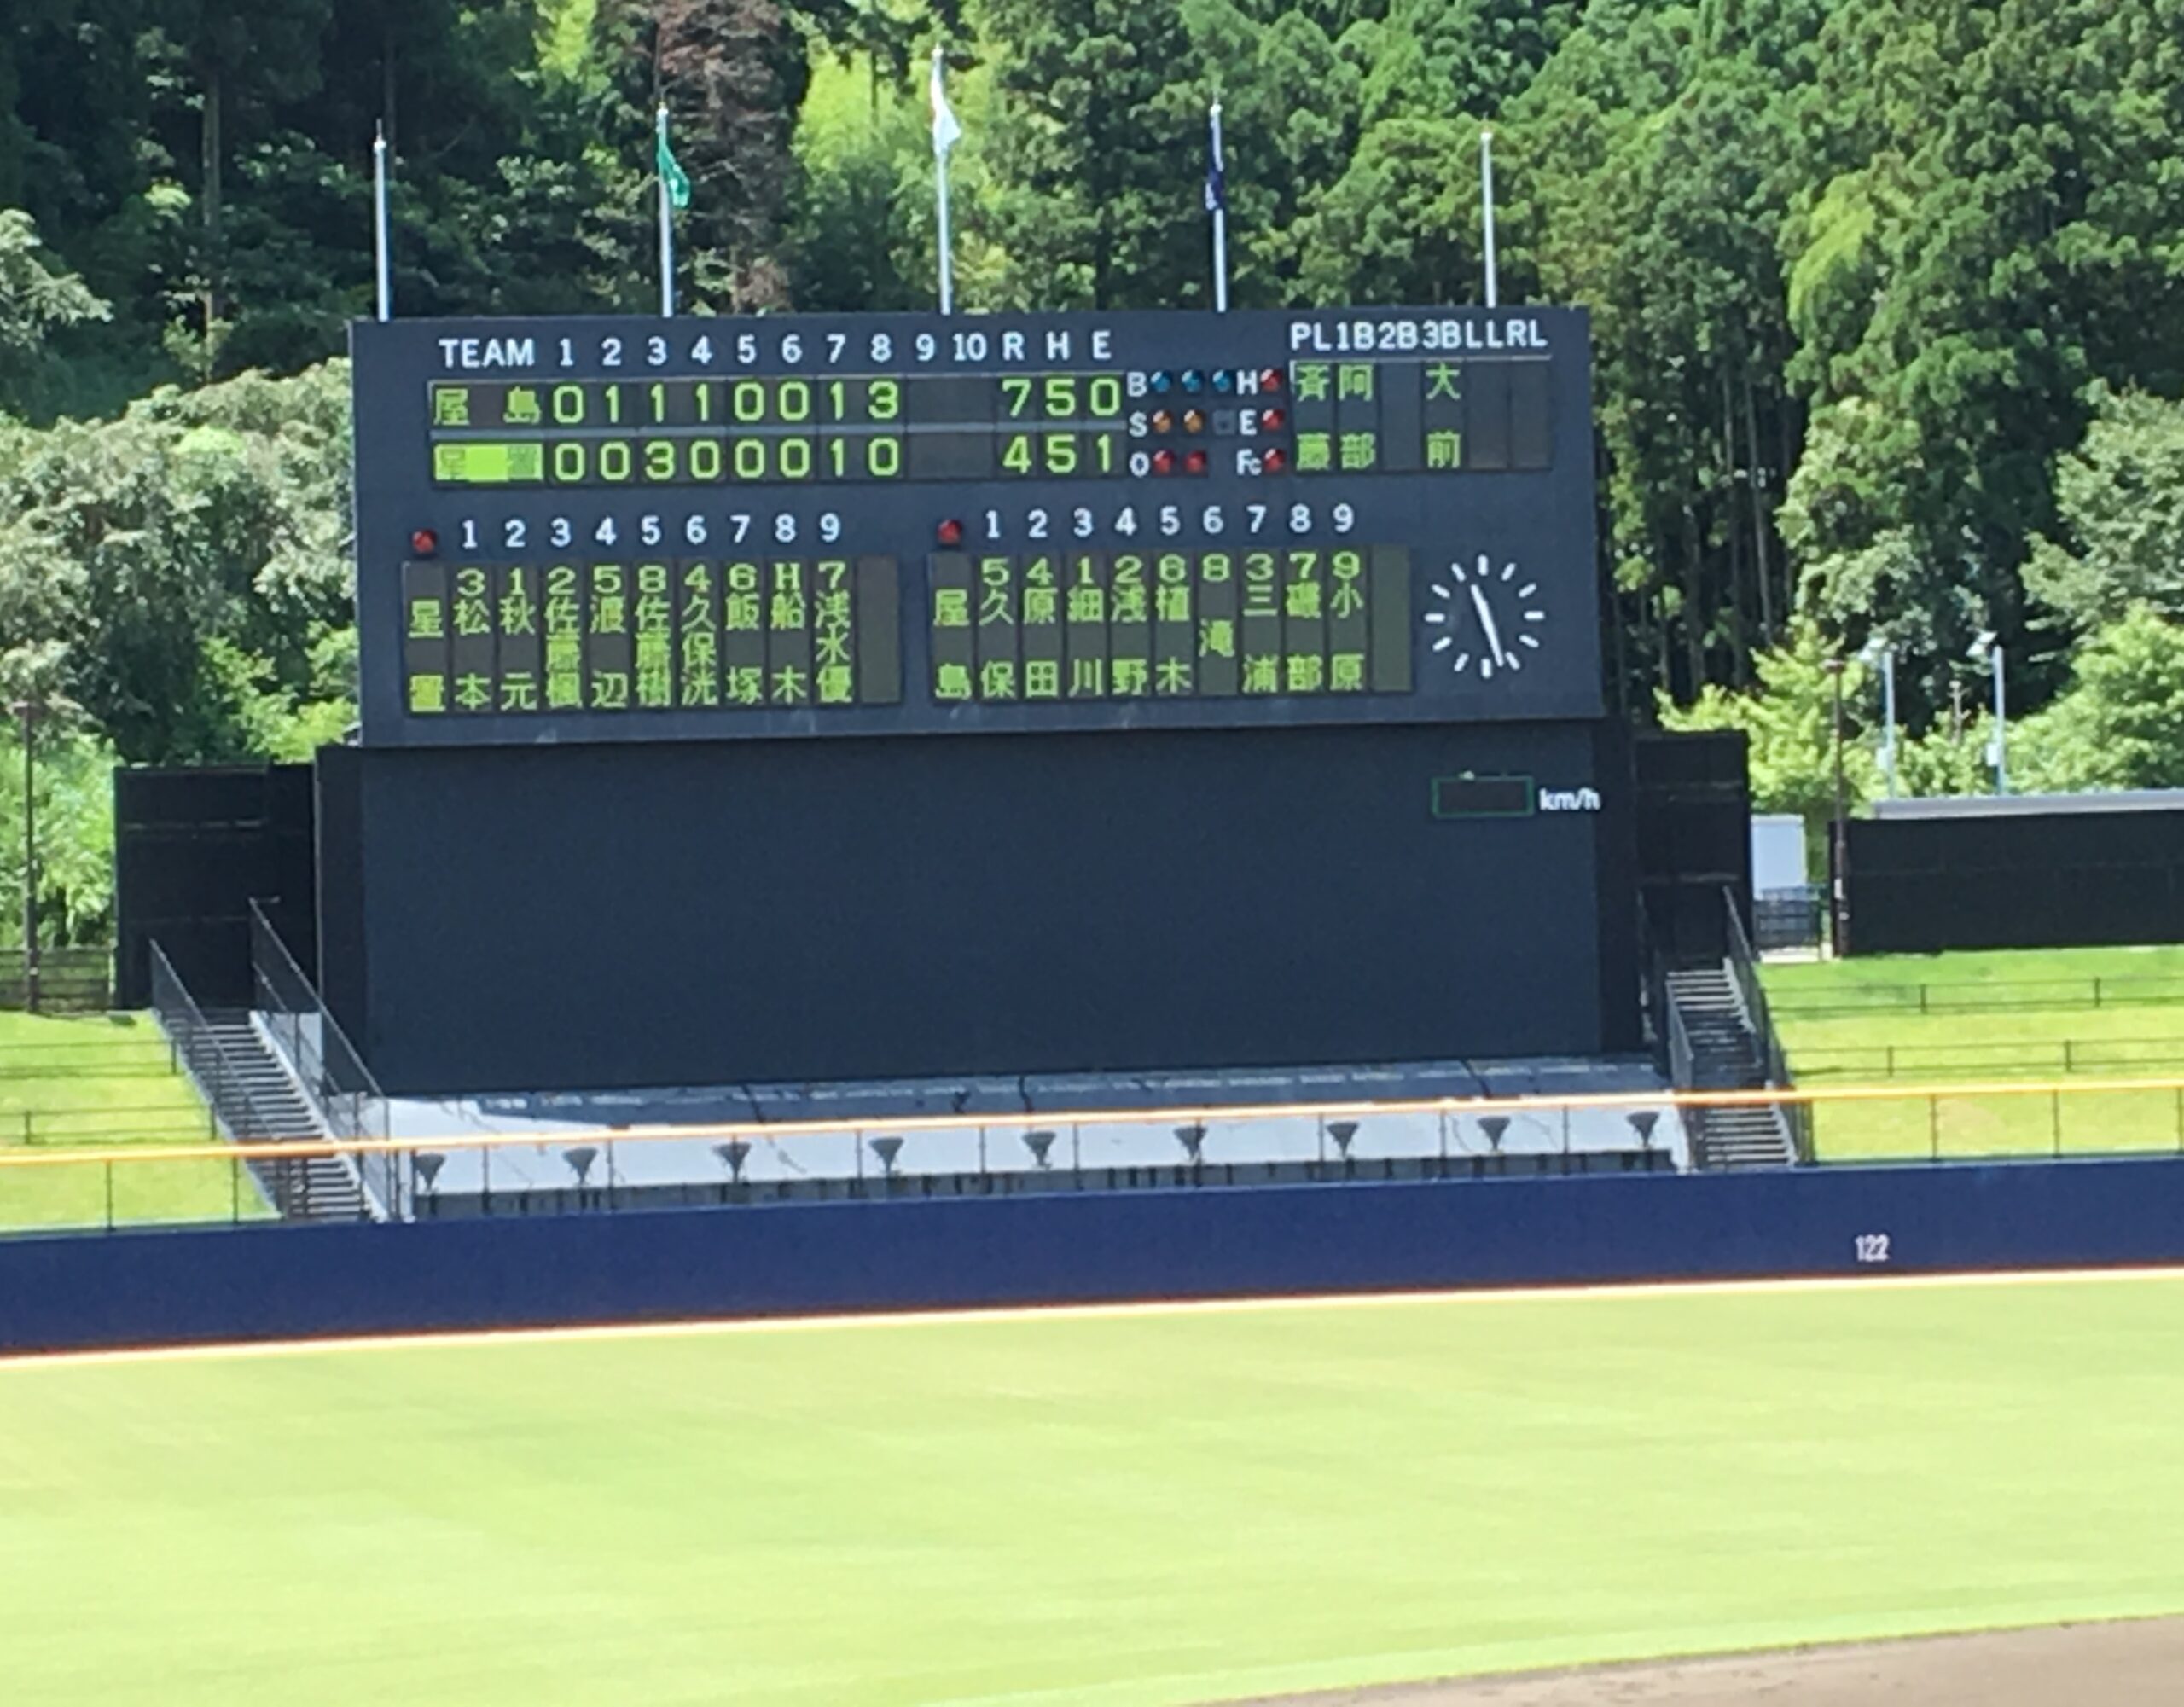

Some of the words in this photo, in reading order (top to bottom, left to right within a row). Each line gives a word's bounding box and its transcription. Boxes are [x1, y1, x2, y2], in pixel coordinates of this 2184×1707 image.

[438, 338, 535, 368] TEAM
[561, 338, 573, 366] 1
[601, 338, 621, 365] 2
[648, 336, 666, 365] 3
[691, 336, 712, 363] 4
[739, 334, 756, 363] 5
[782, 334, 802, 363] 6
[828, 334, 845, 363] 7
[871, 334, 891, 362] 8
[916, 334, 934, 361] 9
[954, 333, 986, 361] 10
[1002, 332, 1024, 360] R
[1047, 331, 1069, 359] H
[1093, 331, 1111, 359] E
[1291, 322, 1331, 351] PL
[1336, 322, 1375, 351] 1B
[1378, 321, 1419, 350] 2B
[1422, 320, 1462, 350] 3B
[1465, 321, 1504, 348] LL
[1507, 319, 1548, 347] RL
[1127, 371, 1147, 397] B
[1236, 370, 1258, 395] H
[554, 386, 584, 423] 0
[606, 385, 619, 423] 1
[651, 384, 664, 422] 1
[696, 383, 708, 421] 1
[735, 382, 764, 421] 0
[779, 381, 810, 421] 0
[830, 381, 844, 420] 1
[868, 380, 898, 419] 3
[1002, 379, 1031, 417] 7
[1046, 378, 1076, 416] 5
[1090, 378, 1120, 416] 0
[1128, 411, 1148, 438] S
[1239, 409, 1258, 436] E
[555, 443, 585, 481] 0
[600, 441, 630, 480] 0
[644, 441, 675, 480] 3
[690, 440, 720, 479] 0
[735, 439, 765, 479] 0
[780, 438, 810, 478] 0
[831, 438, 844, 477] 1
[868, 438, 898, 476] 0
[1002, 435, 1032, 473] 4
[1047, 434, 1077, 473] 5
[1097, 434, 1110, 472] 1
[463, 520, 477, 548] 1
[505, 520, 526, 547] 2
[551, 518, 571, 547] 3
[595, 517, 616, 544] 4
[642, 515, 660, 545] 5
[687, 515, 706, 544] 6
[731, 514, 750, 543] 7
[775, 514, 795, 542] 8
[821, 513, 839, 541] 9
[987, 510, 999, 538] 1
[1029, 509, 1047, 537] 2
[1074, 508, 1092, 537] 3
[1115, 508, 1136, 535] 4
[1161, 506, 1180, 535] 5
[1204, 506, 1223, 533] 6
[1248, 505, 1266, 532] 7
[1291, 504, 1310, 532] 8
[1333, 503, 1353, 531] 9
[593, 565, 621, 593] 5
[638, 565, 667, 593] 8
[684, 564, 712, 593] 4
[729, 562, 757, 591] 6
[774, 562, 800, 590] H
[818, 561, 846, 589] 7
[982, 557, 1010, 586] 5
[1026, 557, 1054, 585] 4
[1078, 557, 1094, 584] 1
[1114, 555, 1143, 584] 2
[1159, 554, 1187, 582] 6
[1202, 553, 1231, 582] 8
[1246, 553, 1274, 581] 3
[1289, 552, 1317, 579] 7
[1332, 551, 1360, 579] 9
[456, 567, 485, 596] 3
[510, 567, 525, 595] 1
[548, 566, 576, 595] 2
[979, 589, 1015, 698] 久保
[1066, 585, 1104, 698] 細川
[1242, 584, 1280, 693] 三浦
[1328, 581, 1365, 691] 小原
[453, 598, 491, 711] 松本
[499, 595, 537, 711] 秋元
[1539, 787, 1601, 810] km/h
[1855, 1234, 1891, 1262] 122
